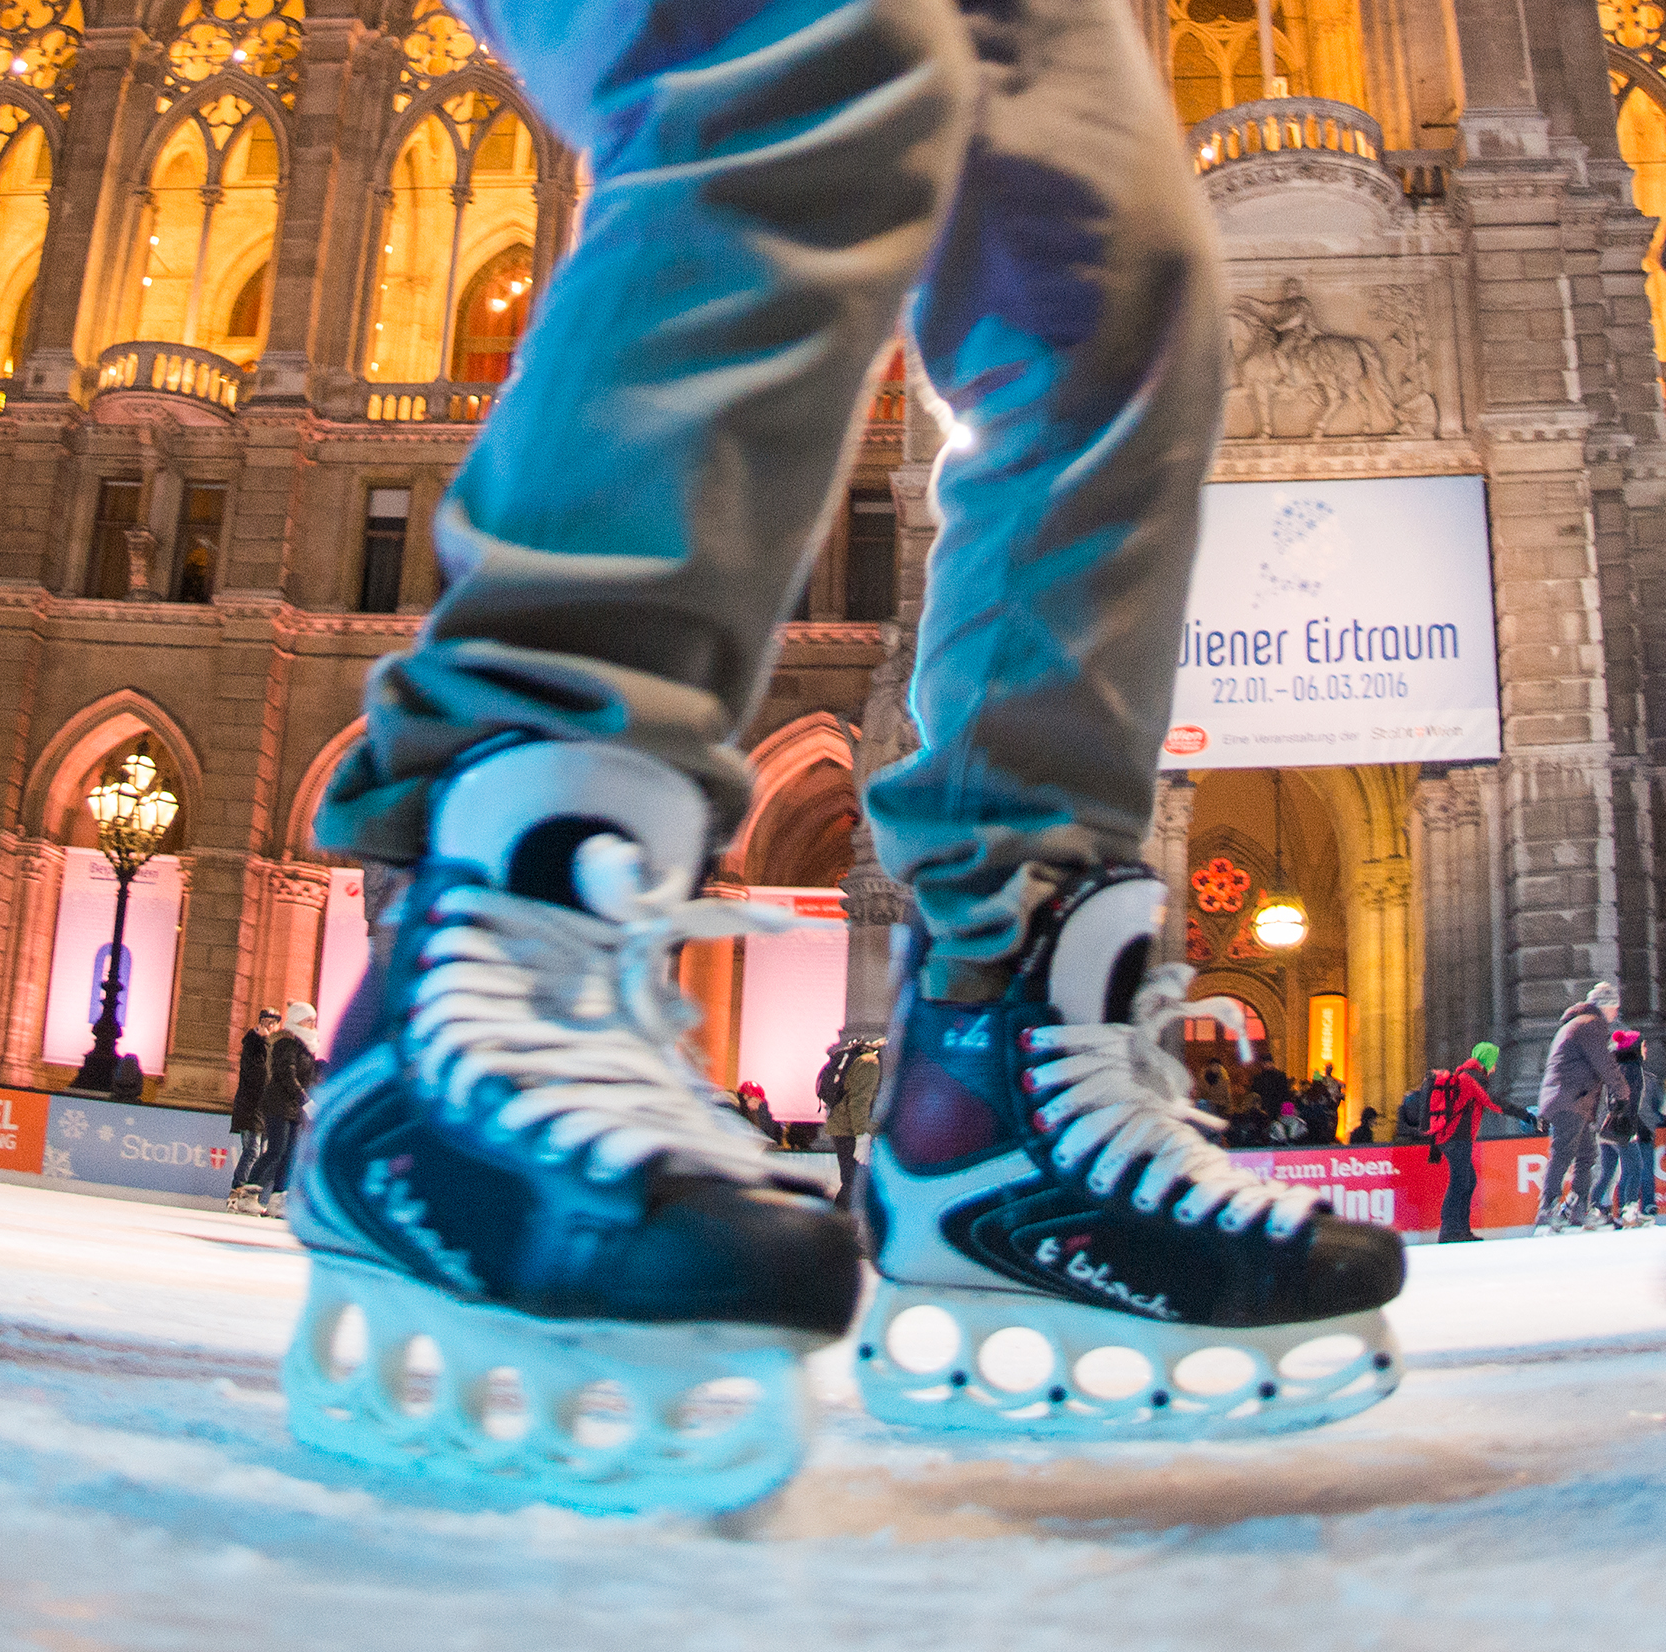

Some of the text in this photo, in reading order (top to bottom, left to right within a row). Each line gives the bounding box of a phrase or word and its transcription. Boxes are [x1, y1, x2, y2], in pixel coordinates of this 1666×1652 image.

[1306, 616, 1459, 664] Eistraum
[1274, 1162, 1327, 1180] zum
[1330, 1156, 1401, 1176] leben.
